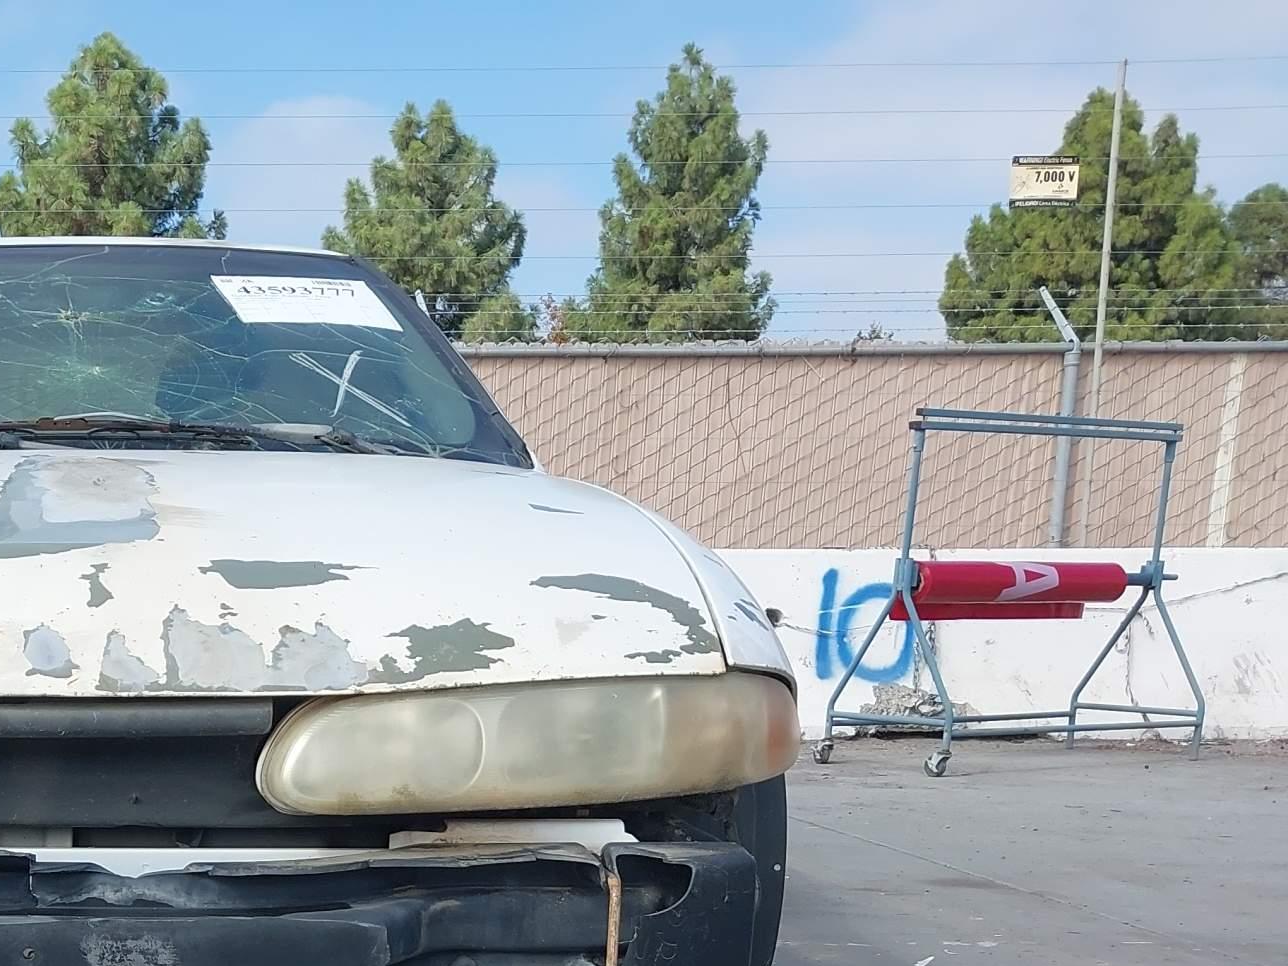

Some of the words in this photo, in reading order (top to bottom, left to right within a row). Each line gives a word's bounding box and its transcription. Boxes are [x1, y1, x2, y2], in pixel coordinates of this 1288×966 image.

[1035, 170, 1065, 184] 7,000
[1068, 170, 1076, 182] V
[237, 286, 355, 298] 43593777
